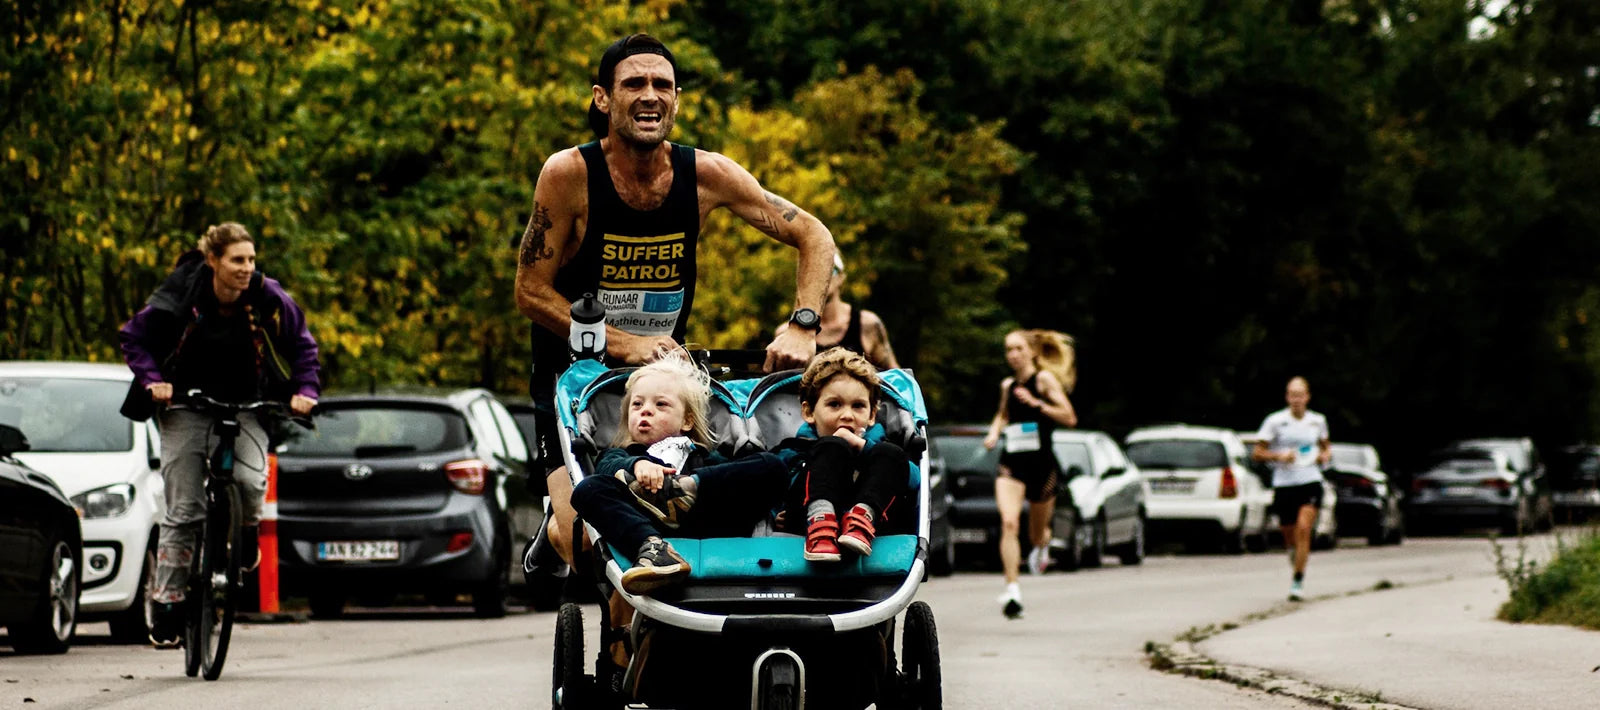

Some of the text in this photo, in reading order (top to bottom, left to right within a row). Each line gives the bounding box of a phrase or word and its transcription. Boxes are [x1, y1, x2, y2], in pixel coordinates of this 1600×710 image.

[602, 243, 685, 261] SUFFER
[602, 264, 681, 280] PATROL
[602, 293, 639, 305] RUNAAR
[604, 316, 646, 327] Mathieu
